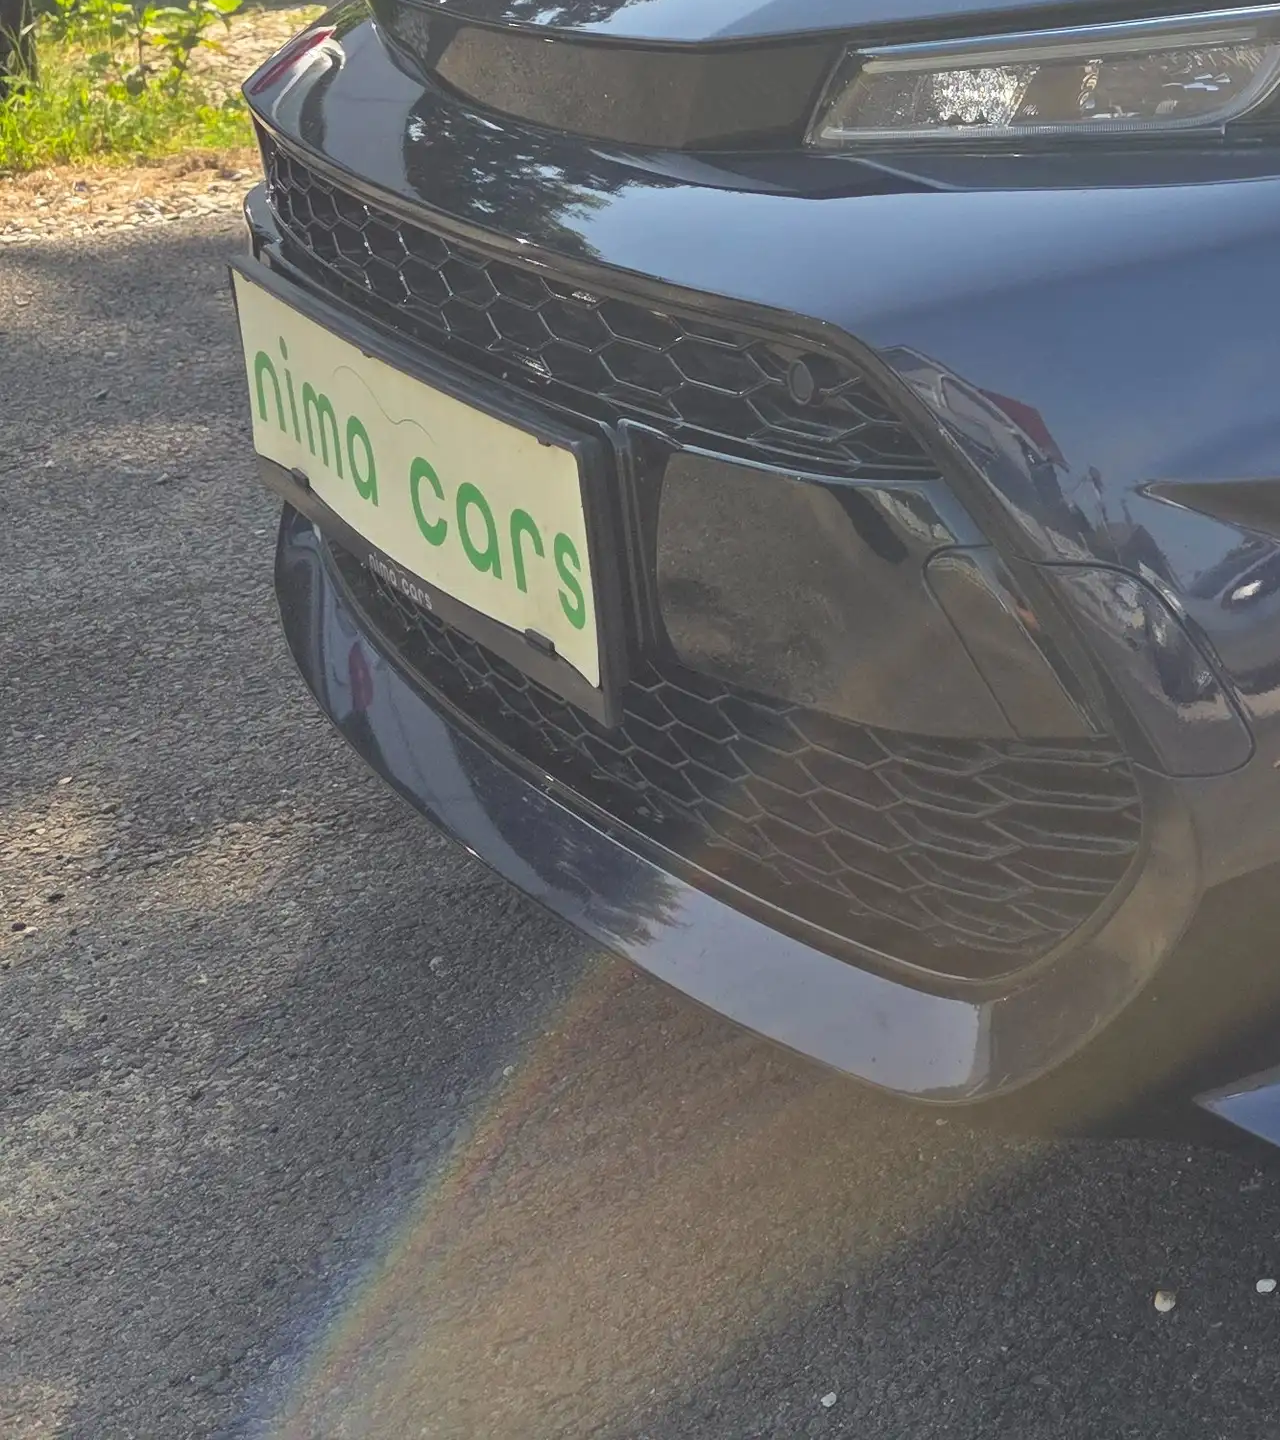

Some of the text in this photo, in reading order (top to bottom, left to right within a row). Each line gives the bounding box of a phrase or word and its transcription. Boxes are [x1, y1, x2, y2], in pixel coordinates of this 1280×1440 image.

[254, 336, 586, 630] nima cars
[368, 551, 433, 611] nima cars
